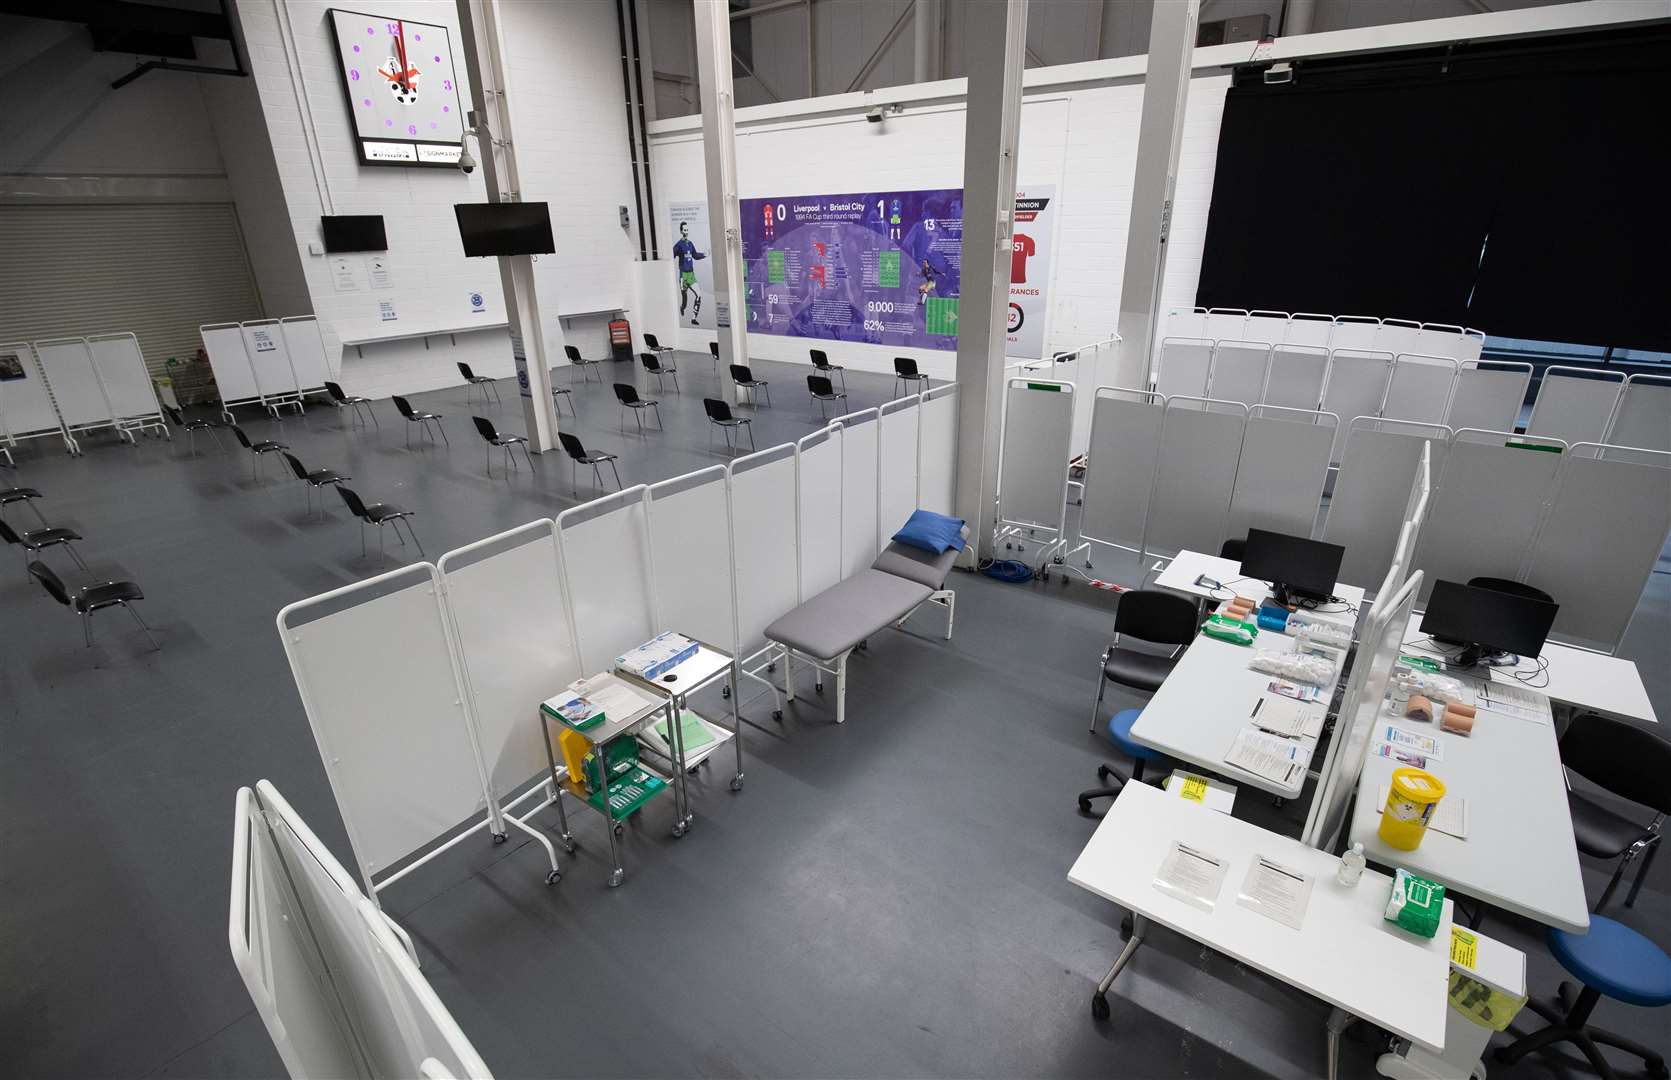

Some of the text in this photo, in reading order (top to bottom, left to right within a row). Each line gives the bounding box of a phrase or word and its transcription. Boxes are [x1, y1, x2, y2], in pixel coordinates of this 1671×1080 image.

[350, 69, 360, 81] 9
[444, 79, 452, 91] 3
[408, 124, 417, 136] 6
[777, 203, 786, 221] 0
[793, 203, 820, 213] Liverpool
[830, 201, 850, 212] Bristol
[851, 200, 865, 212] City
[877, 199, 884, 219] 1
[805, 212, 812, 220] FA
[813, 212, 822, 221] Cup
[822, 212, 833, 220] third
[834, 211, 847, 220] round
[923, 218, 935, 231] 13
[1010, 288, 1040, 296] RANCES
[768, 293, 779, 305] 59
[863, 319, 885, 332] 62%
